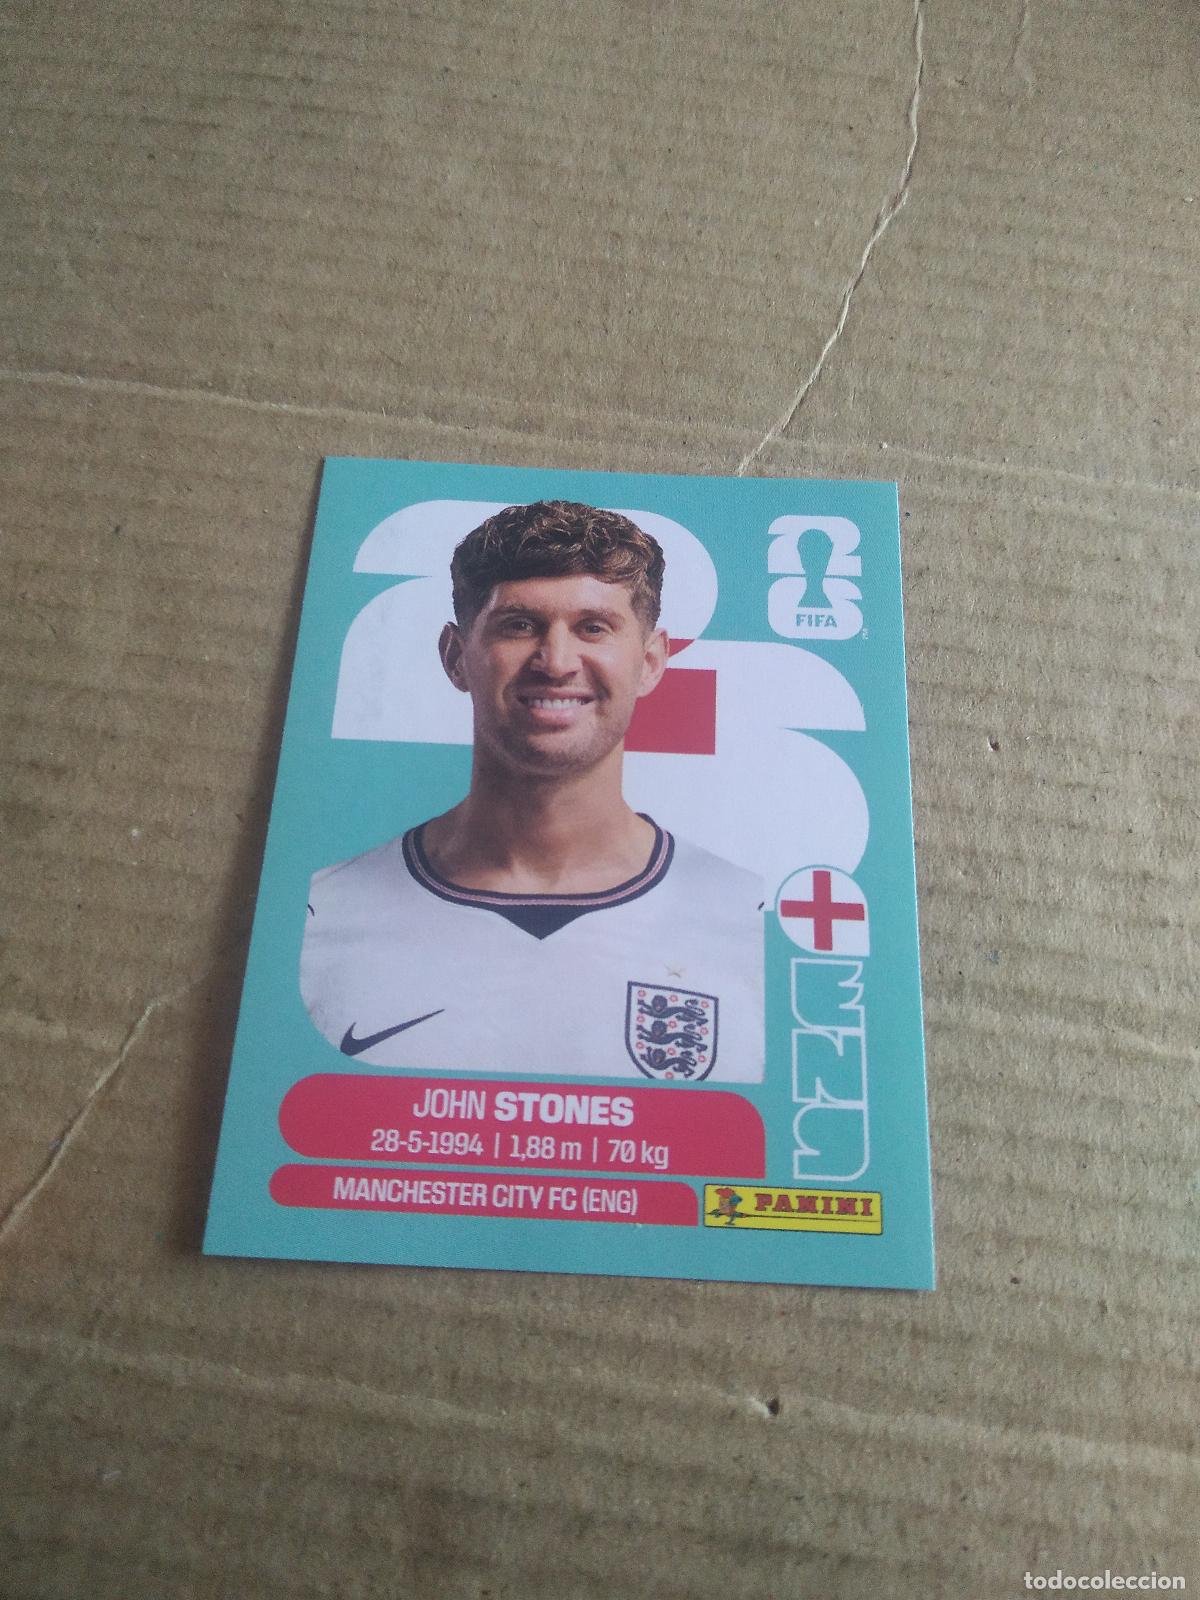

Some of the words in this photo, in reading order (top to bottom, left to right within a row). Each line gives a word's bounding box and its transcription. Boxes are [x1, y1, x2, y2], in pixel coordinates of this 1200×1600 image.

[796, 613, 837, 628] FIFA
[413, 1088, 486, 1120] JOHN
[494, 1091, 634, 1127] STONES
[370, 1129, 483, 1156] 28-5-1994
[510, 1135, 555, 1161] 1,88
[561, 1141, 582, 1161] m
[608, 1139, 635, 1163] 70
[641, 1140, 669, 1169] kg
[333, 1176, 487, 1207] MANCHESTER
[492, 1184, 543, 1209] CITY
[549, 1188, 577, 1211] FC
[583, 1186, 638, 1216] (ENG)
[755, 1193, 873, 1217] PANINI
